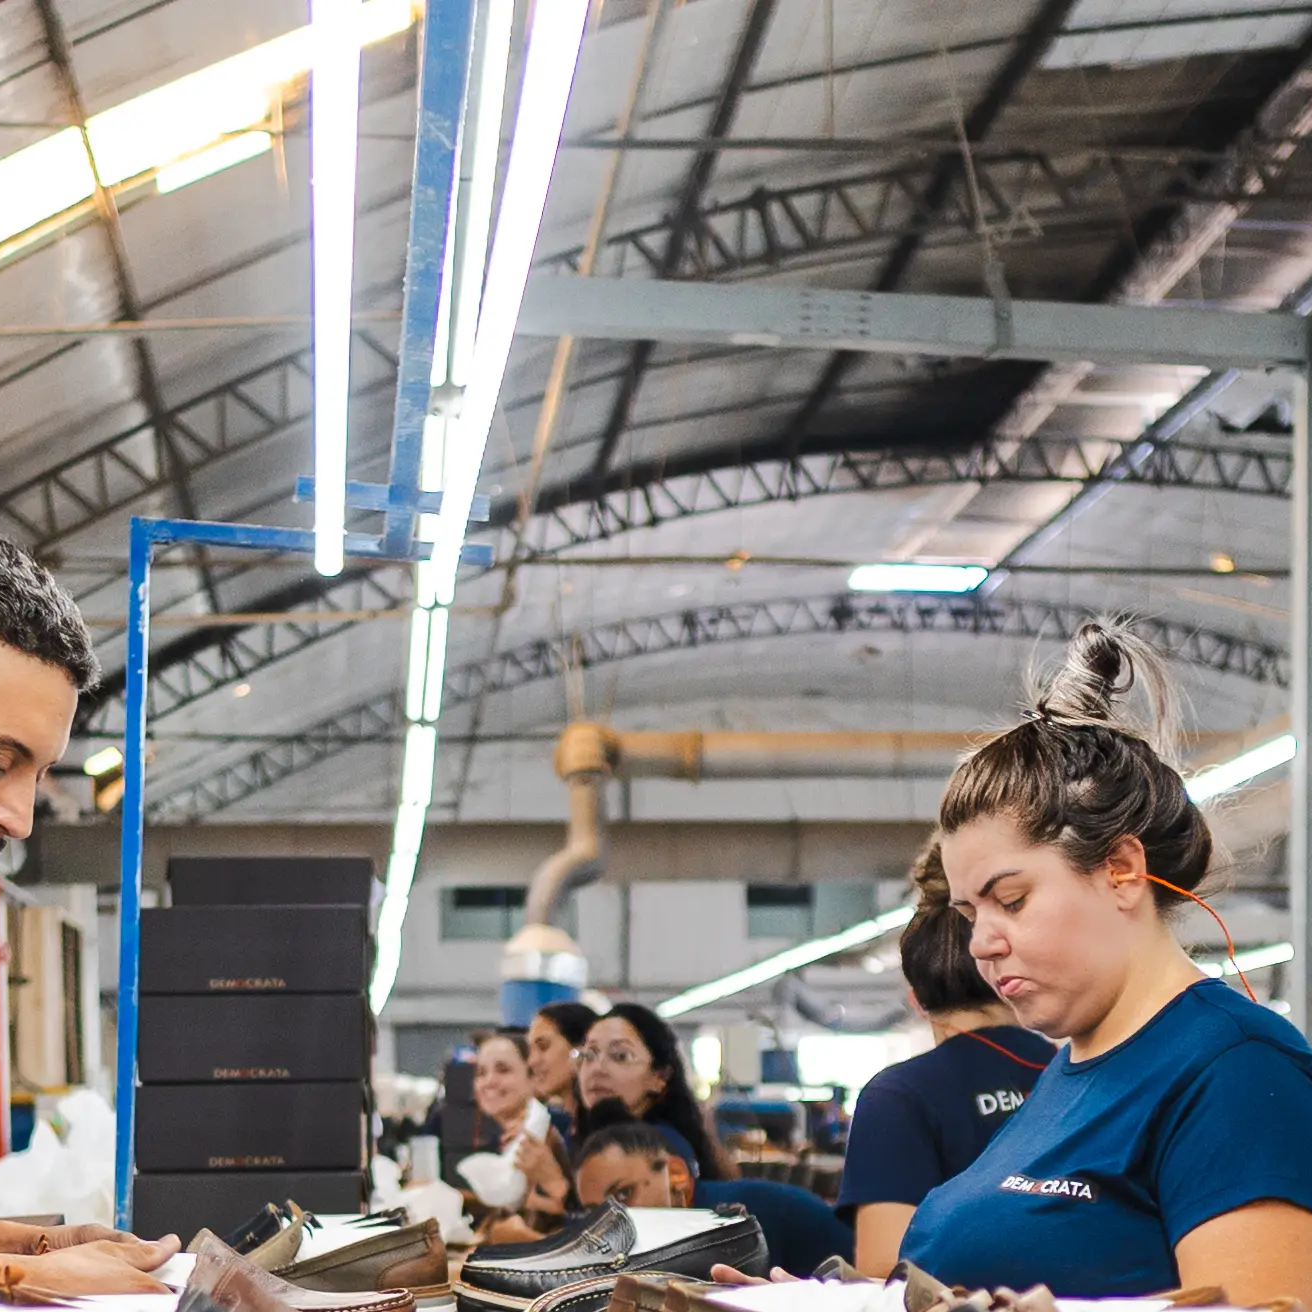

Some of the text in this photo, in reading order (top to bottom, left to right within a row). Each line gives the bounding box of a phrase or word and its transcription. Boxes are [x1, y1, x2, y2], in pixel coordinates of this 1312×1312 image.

[209, 978, 287, 990] DEMOCRATA
[213, 1067, 292, 1079] DEMOCRATA
[976, 1089, 1032, 1116] DEM
[1001, 1175, 1093, 1200] DEMOCRATA
